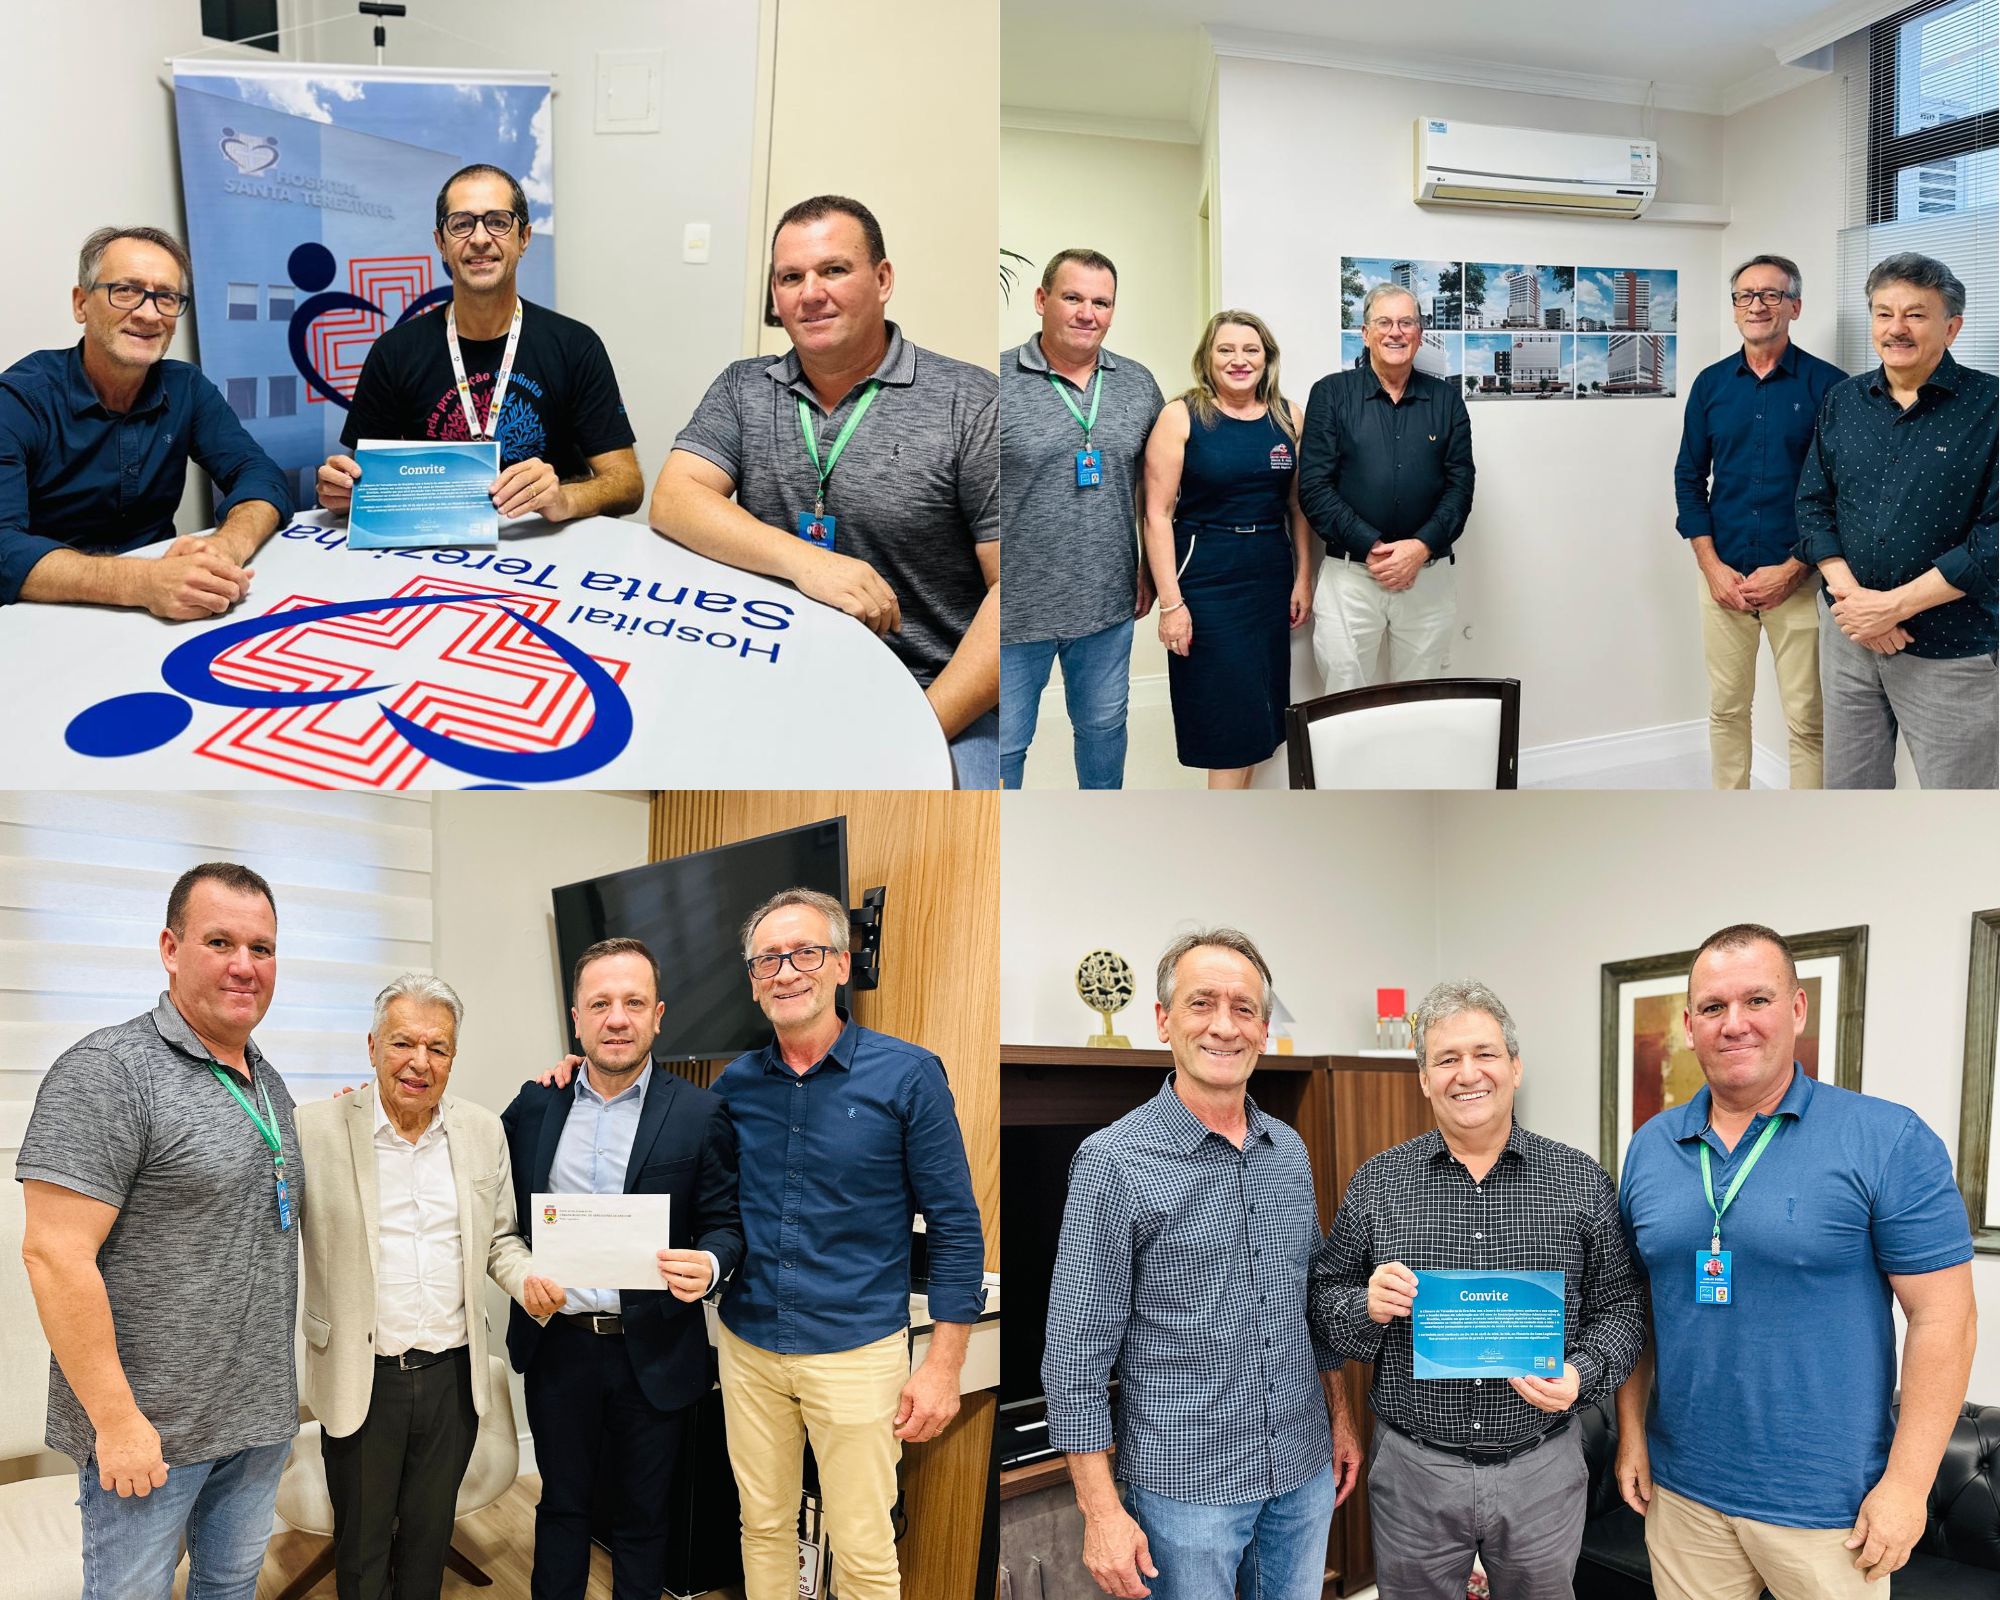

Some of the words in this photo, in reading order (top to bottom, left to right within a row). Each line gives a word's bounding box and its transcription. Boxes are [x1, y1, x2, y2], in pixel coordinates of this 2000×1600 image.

[224, 178, 292, 203] SANTA
[300, 190, 396, 220] TEREZINHA
[276, 173, 360, 199] HOSPITAL
[427, 412, 440, 437] pela
[508, 372, 543, 398] nfinita
[400, 464, 446, 476] Convite
[281, 524, 559, 589] Terezha
[580, 570, 795, 631] Santa
[567, 605, 781, 663] Hospital
[1460, 1290, 1509, 1301] Convite
